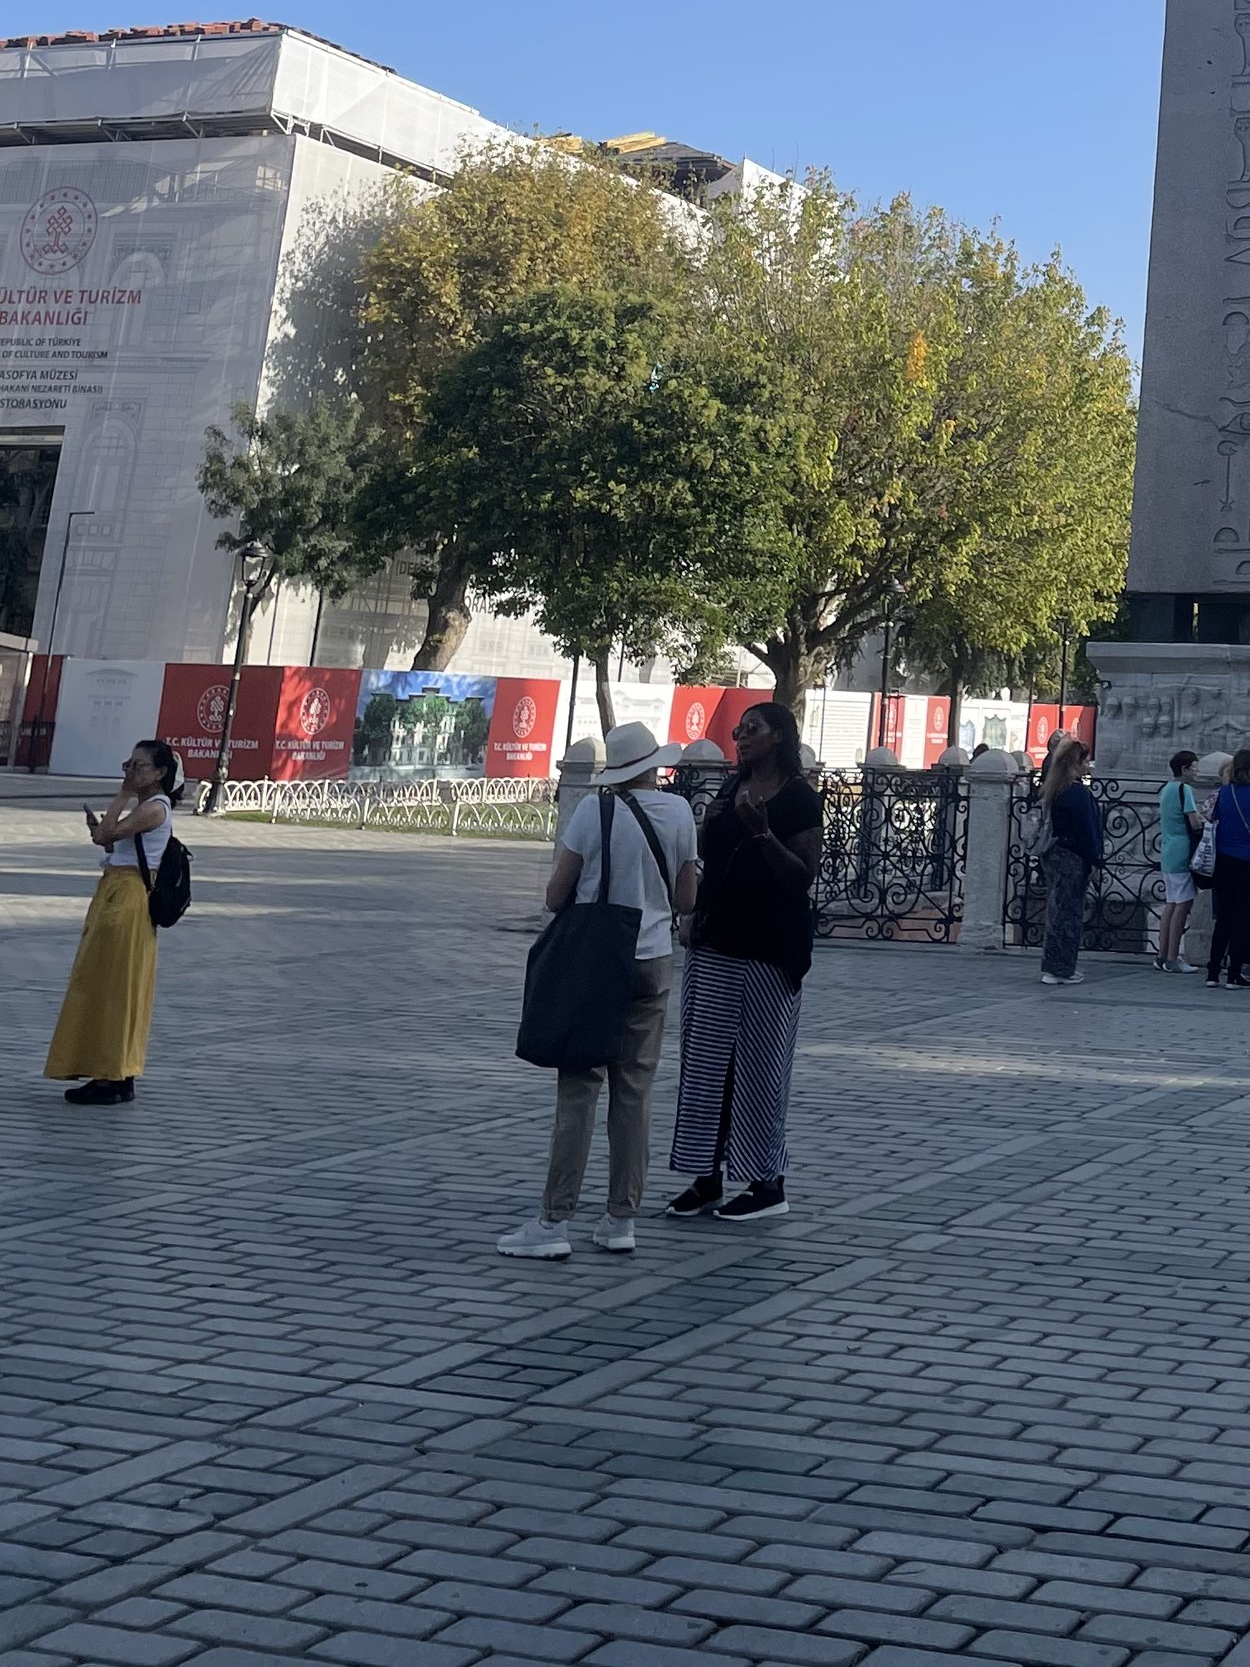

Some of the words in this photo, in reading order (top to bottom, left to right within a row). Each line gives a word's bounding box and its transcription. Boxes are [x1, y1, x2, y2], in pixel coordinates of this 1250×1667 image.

[53, 290, 73, 304] VE
[79, 287, 142, 304] TURİZM
[0, 308, 88, 326] BAKANLIĞI
[0, 337, 34, 346] EPUBLIC
[35, 338, 46, 346] OF
[48, 336, 81, 346] TÜRKİYE
[14, 351, 49, 359] CULTURE
[51, 351, 70, 359] AND
[71, 351, 108, 359] TOURISM
[40, 368, 79, 381] MÜZESİ
[166, 737, 179, 746] T.C.
[181, 736, 213, 748] KÜLTÜR
[287, 739, 311, 750] KÜLTÜR
[312, 741, 320, 750] VE
[321, 740, 344, 750] TURİZM
